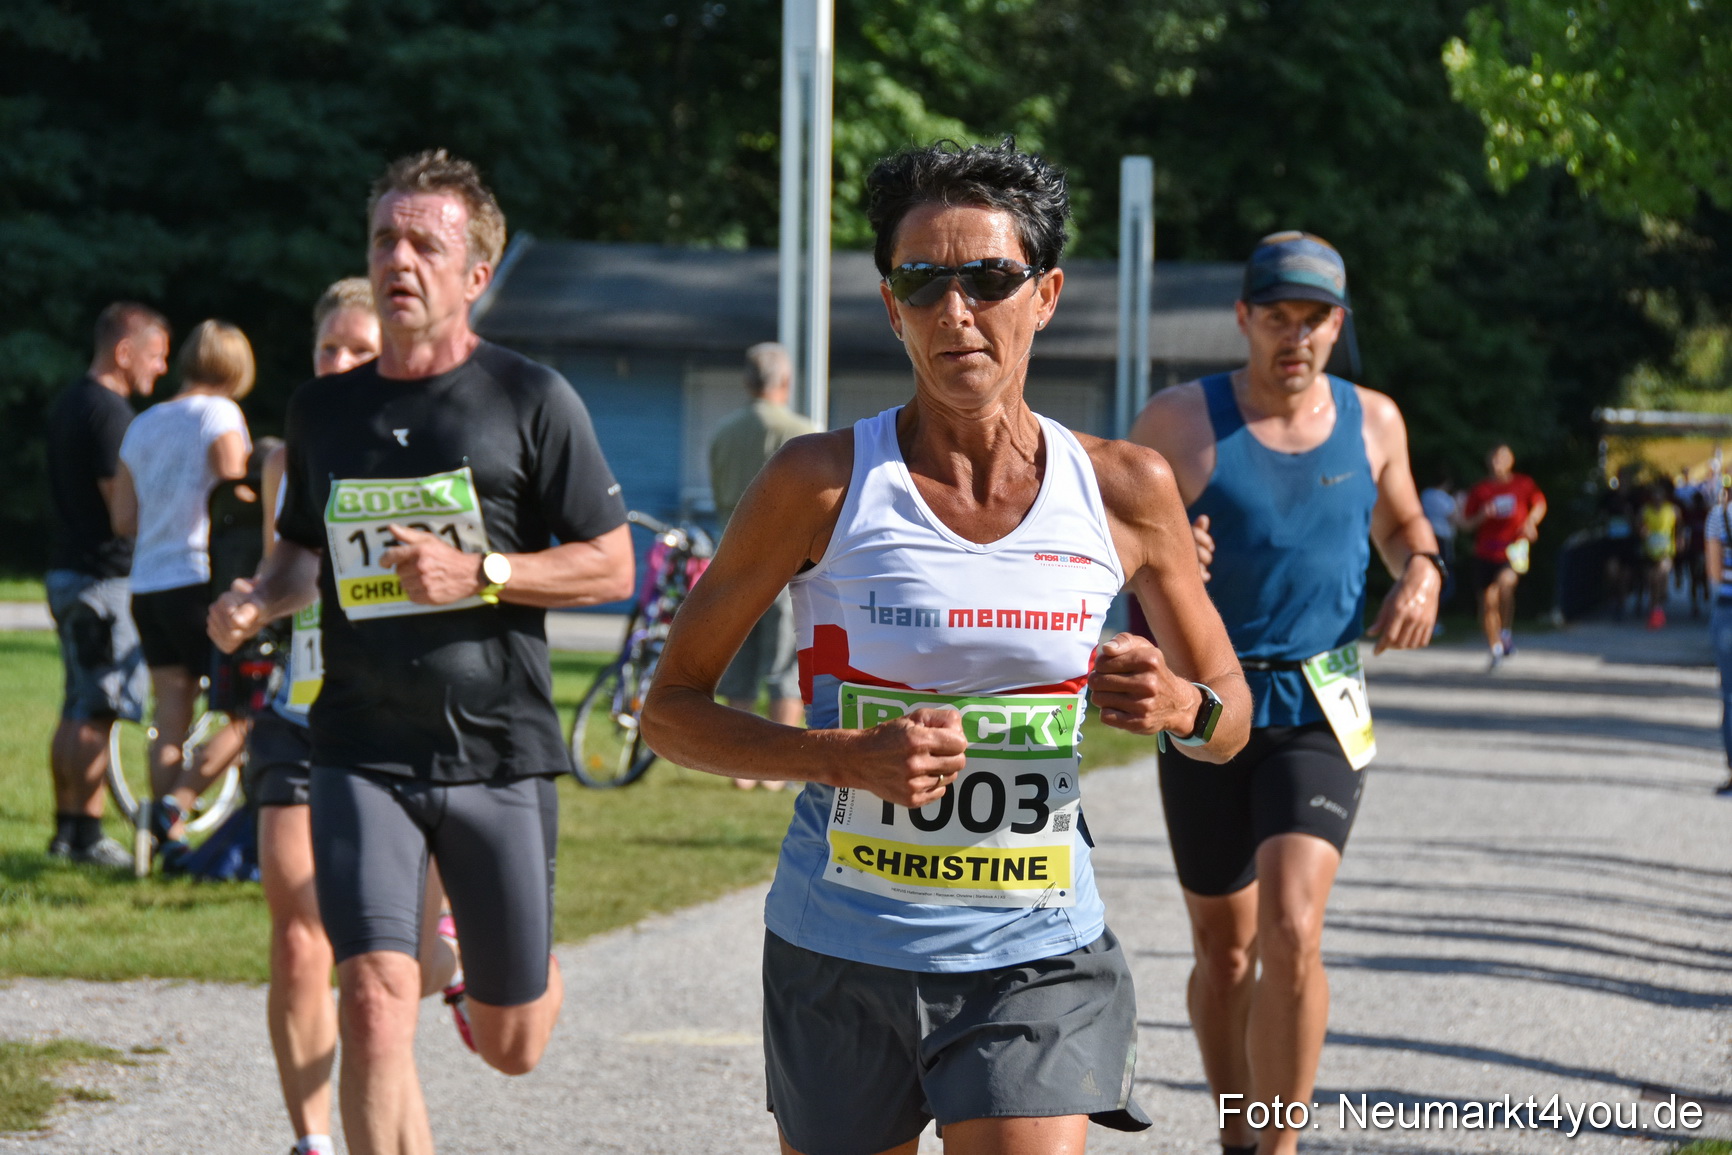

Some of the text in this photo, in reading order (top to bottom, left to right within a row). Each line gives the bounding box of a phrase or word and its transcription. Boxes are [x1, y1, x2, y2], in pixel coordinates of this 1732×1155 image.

[335, 482, 457, 516] BOCK
[350, 580, 402, 601] CHRI
[859, 591, 1093, 632] team memmert
[1058, 777, 1069, 789] A
[833, 787, 849, 825] ZEITGE
[852, 844, 1049, 882] CHRISTINE
